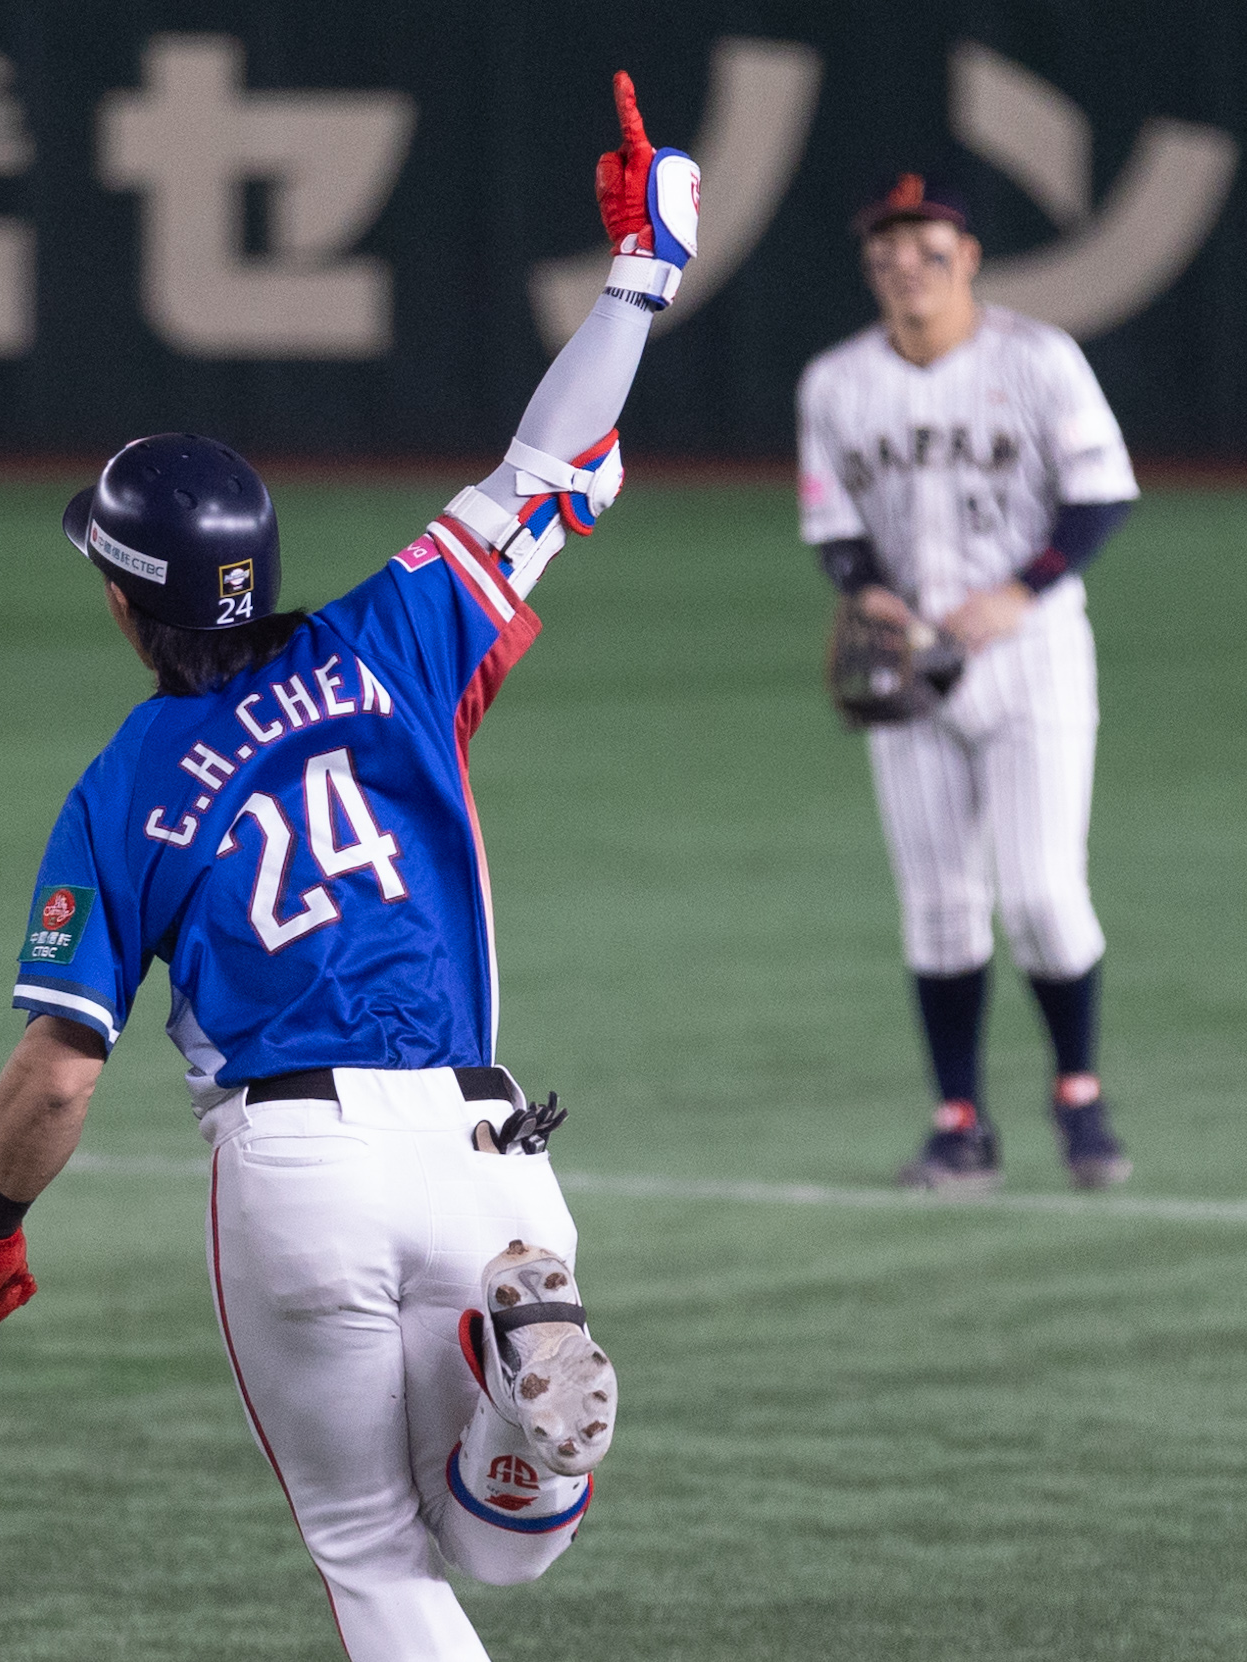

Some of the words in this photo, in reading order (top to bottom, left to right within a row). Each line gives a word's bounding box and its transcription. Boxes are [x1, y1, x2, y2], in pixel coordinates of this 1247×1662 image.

[96, 32, 1242, 358] セノン
[131, 558, 164, 578] CTBC
[217, 592, 253, 624] 24
[215, 746, 409, 955] 24
[32, 946, 58, 958] CTBC
